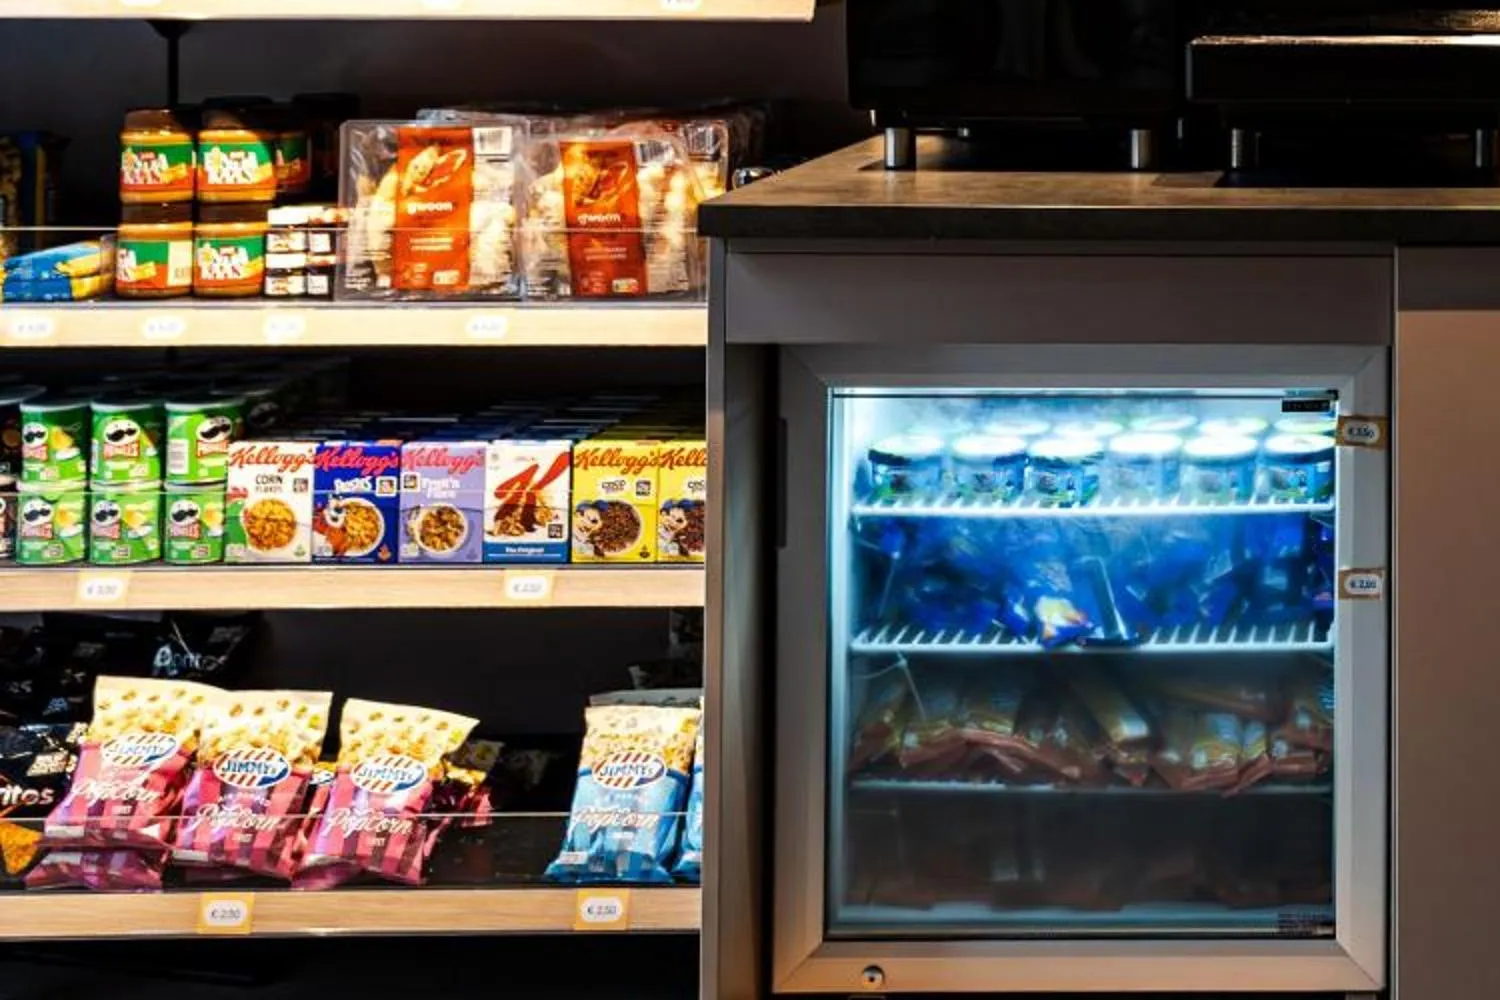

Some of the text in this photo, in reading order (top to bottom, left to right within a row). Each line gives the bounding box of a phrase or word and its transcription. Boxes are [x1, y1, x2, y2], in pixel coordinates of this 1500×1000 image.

[229, 445, 314, 473] Kellogg's
[316, 446, 400, 477] Kellogg's
[401, 446, 483, 474] Kellogg's
[574, 446, 659, 474] Kellogg's
[255, 474, 283, 485] CORN
